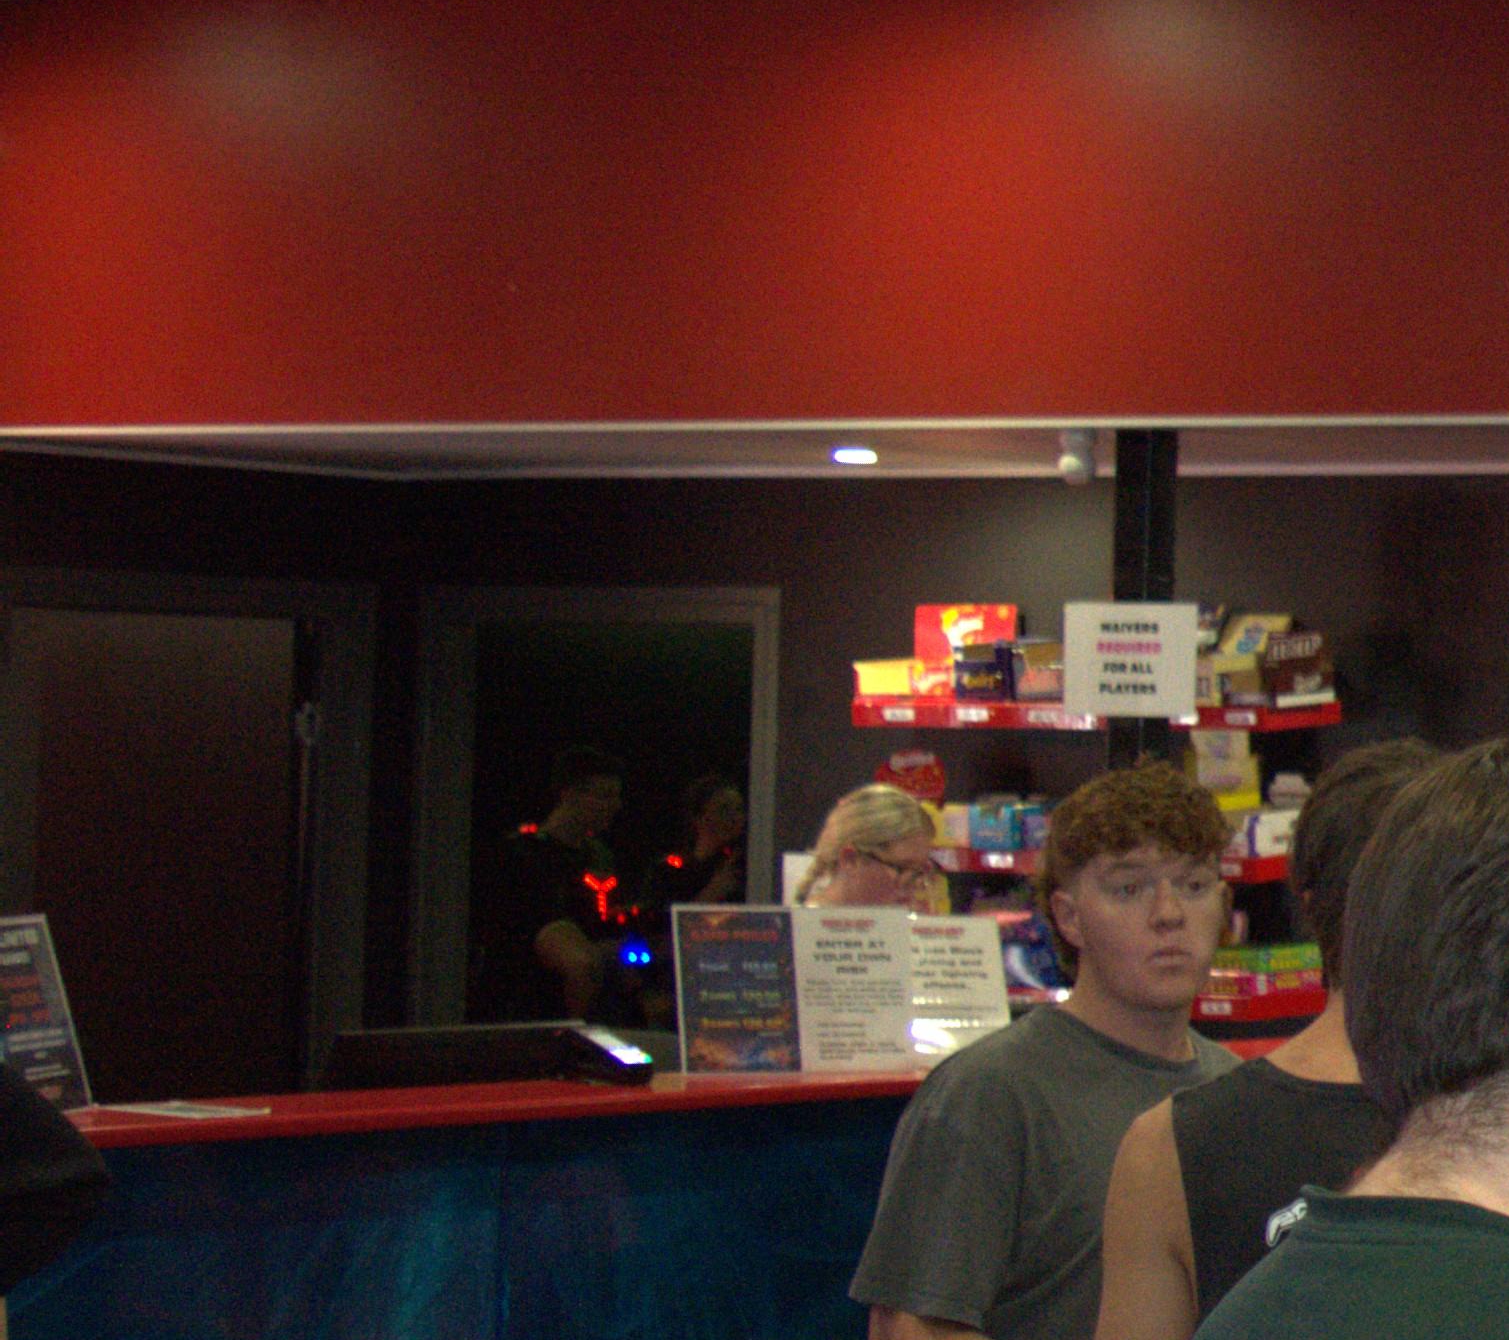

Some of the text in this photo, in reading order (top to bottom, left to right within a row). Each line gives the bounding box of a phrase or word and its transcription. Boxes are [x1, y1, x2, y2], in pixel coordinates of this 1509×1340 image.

[1100, 623, 1159, 634] WAIVERS
[1103, 663, 1153, 674] FOR ALL
[1099, 683, 1156, 695] PLAYERS
